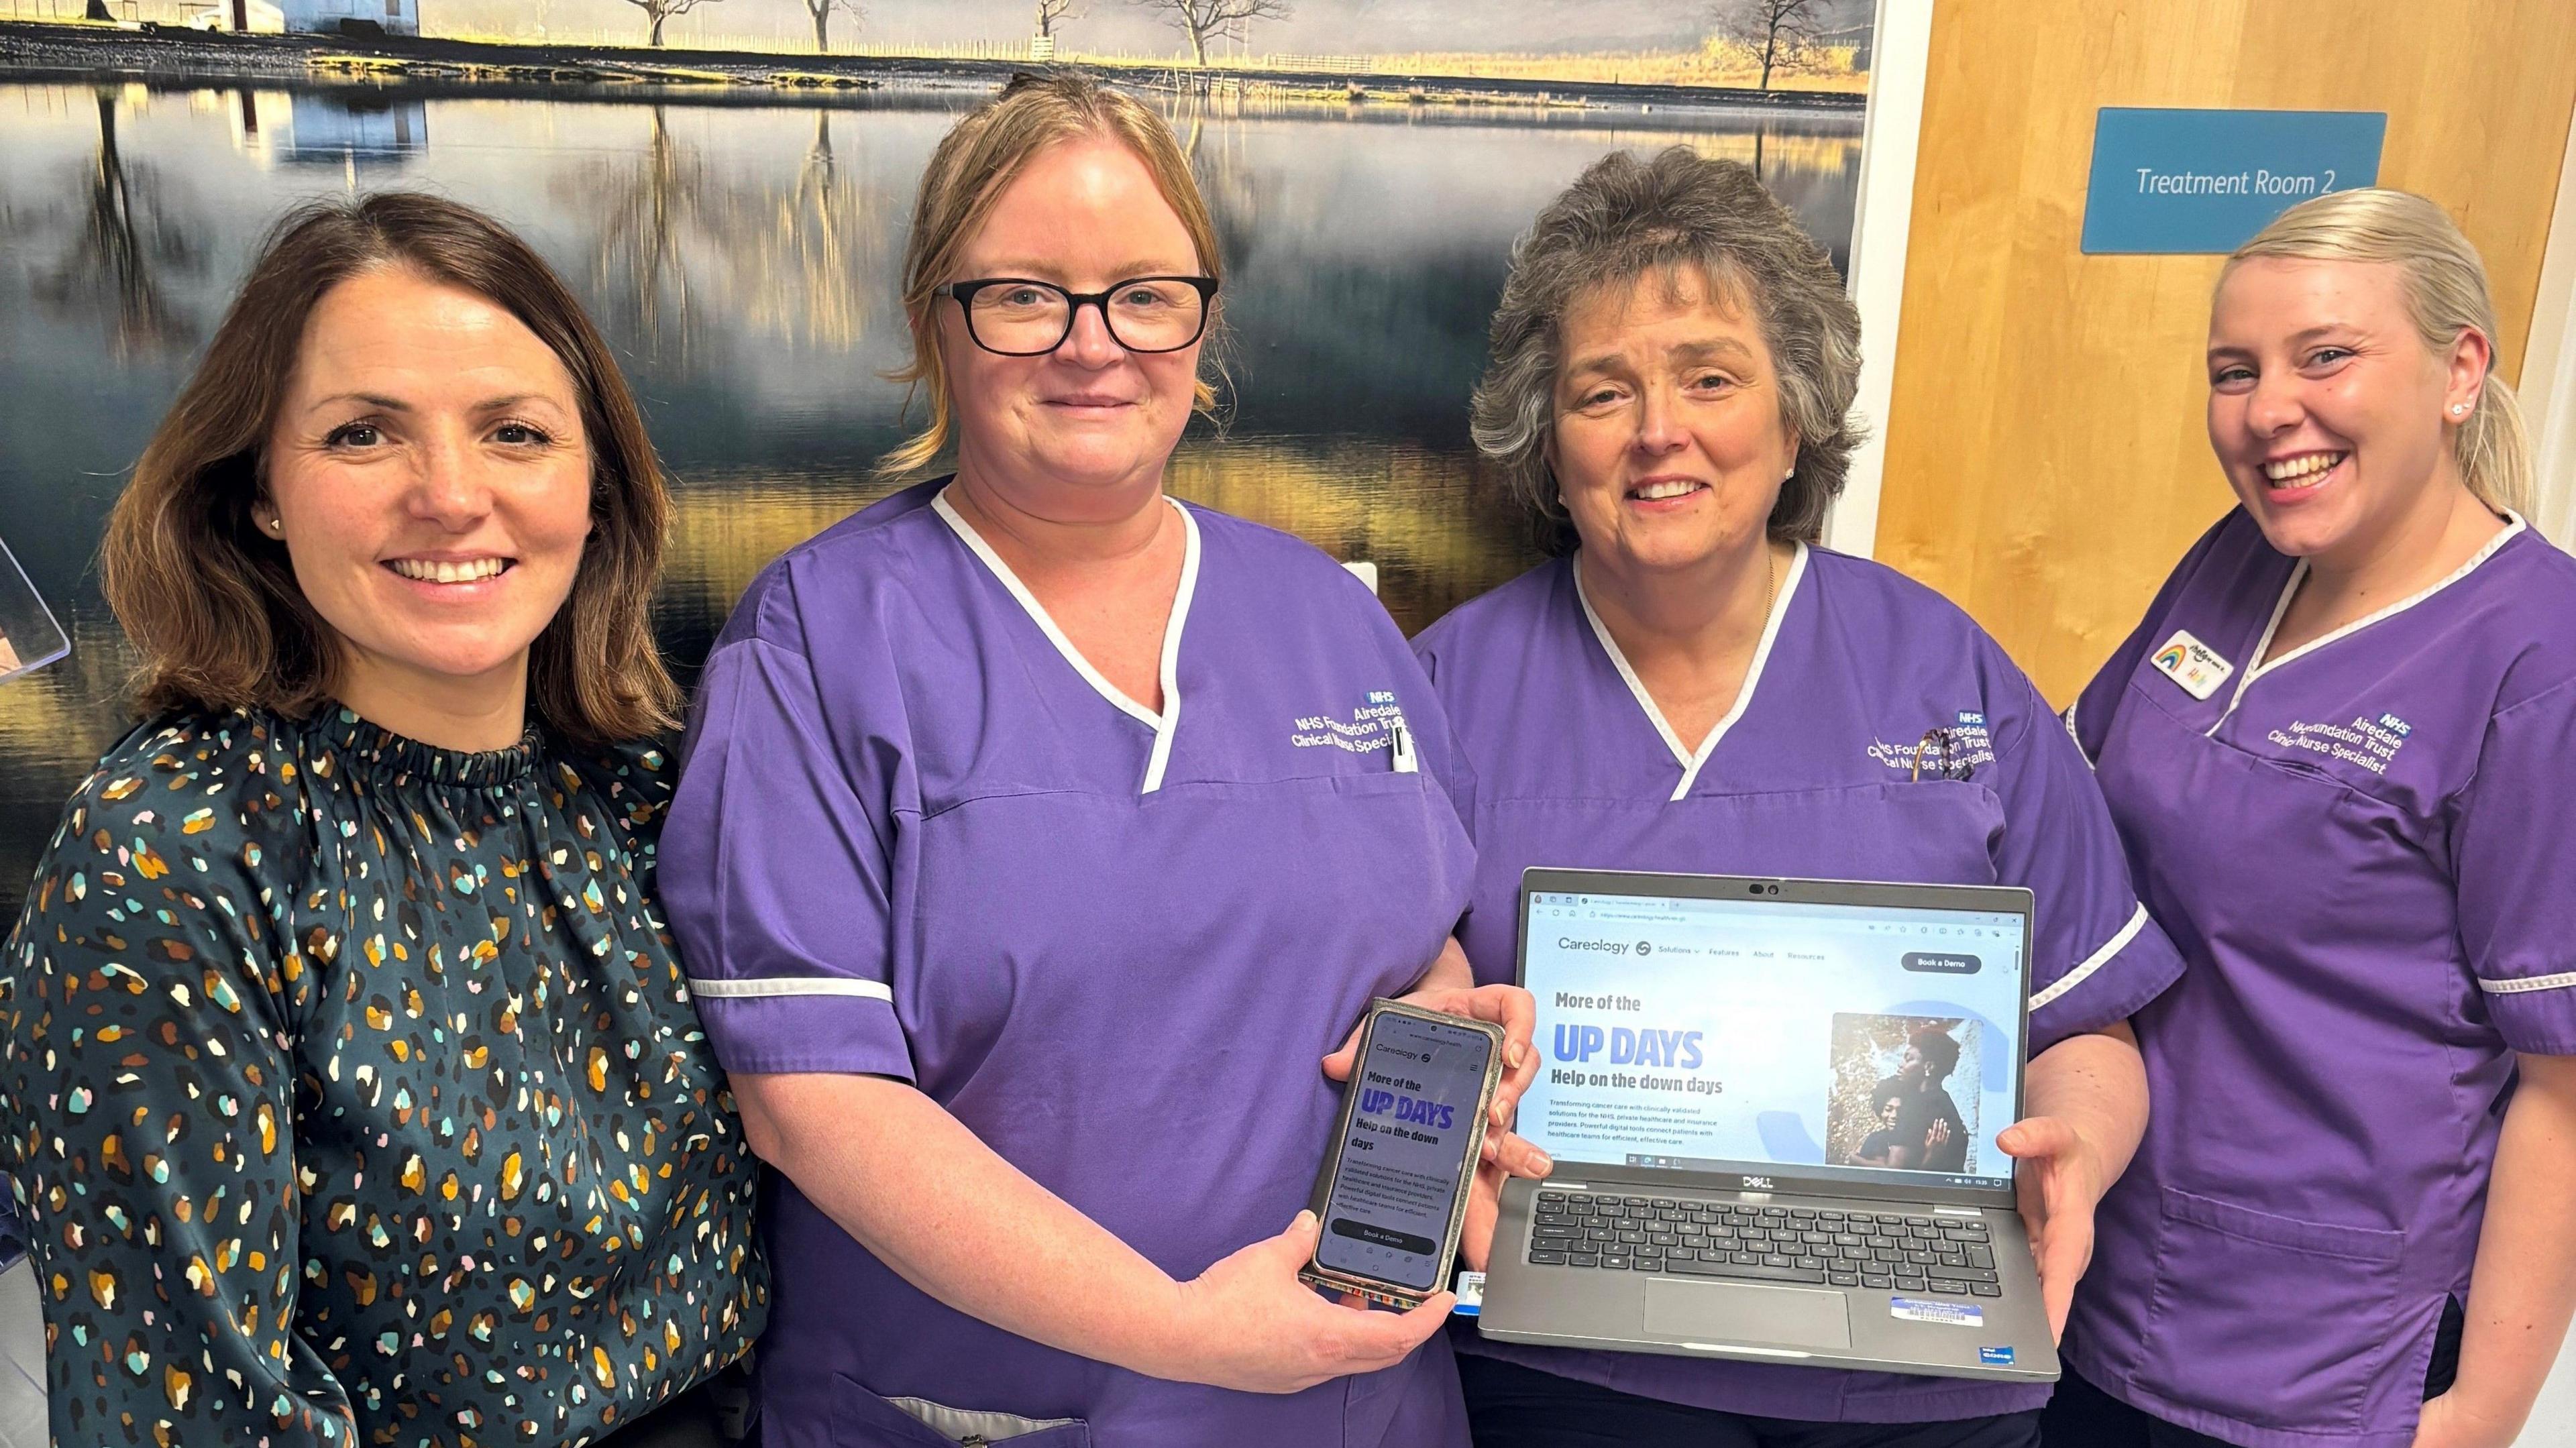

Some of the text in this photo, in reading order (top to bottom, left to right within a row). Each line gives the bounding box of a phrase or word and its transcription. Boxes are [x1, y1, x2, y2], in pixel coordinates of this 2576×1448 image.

[2136, 168, 2336, 194] Treatment Room 2
[1369, 691, 1395, 704] NHS
[1354, 704, 1401, 721] Airedale
[1960, 712, 1984, 724] NHS
[1295, 716, 1324, 731] NHS
[2379, 714, 2411, 736] NHS
[1291, 732, 1334, 747] Clinical
[2351, 716, 2402, 749] Airedale
[1961, 736, 1992, 748] Trust
[2365, 736, 2396, 761] Trust
[2331, 742, 2387, 775] Specialist
[1558, 937, 1629, 954] Careology
[1658, 946, 1691, 954] Solutions
[1709, 948, 1739, 957] Features
[1788, 952, 1825, 960] Resources
[1917, 958, 1936, 966] Book
[1555, 992, 1641, 1011] More of the
[1376, 1044, 1418, 1060] Careology
[1554, 1023, 1703, 1070] UP DAYS
[1367, 1071, 1421, 1092] More of the
[1551, 1069, 1723, 1095] Help on the down days
[1361, 1088, 1454, 1129] UP DAYS
[1550, 1099, 1591, 1109] Transforming
[1644, 1105, 1670, 1113] clinically
[1356, 1117, 1439, 1145] Help on the down
[1351, 1137, 1375, 1151] days
[1743, 1176, 1774, 1188] DELL
[1364, 1229, 1379, 1238] Book
[1385, 1235, 1403, 1243] Demo
